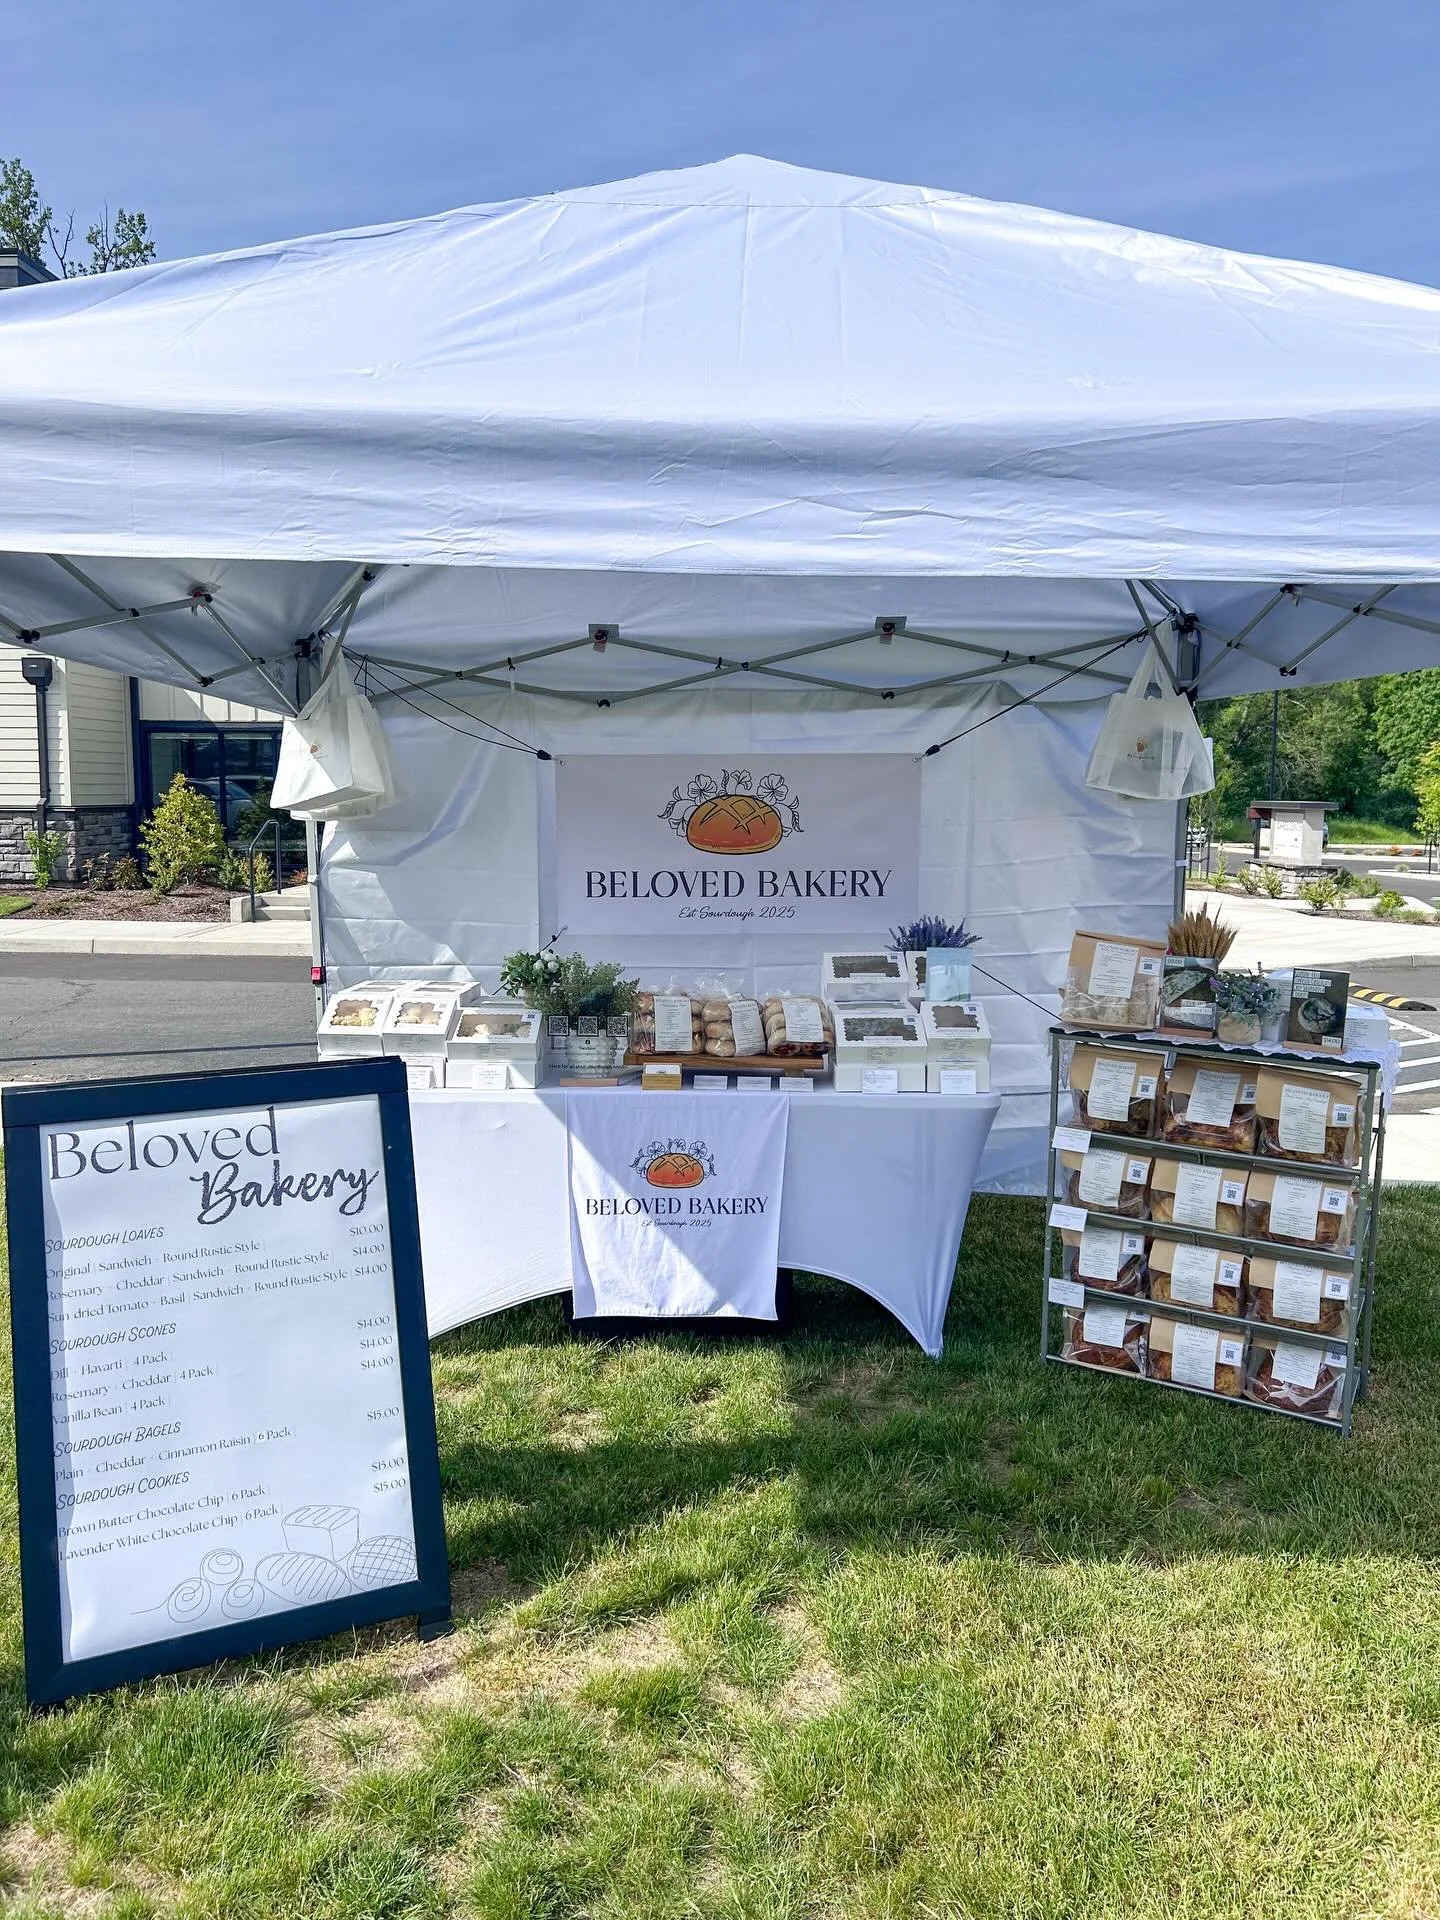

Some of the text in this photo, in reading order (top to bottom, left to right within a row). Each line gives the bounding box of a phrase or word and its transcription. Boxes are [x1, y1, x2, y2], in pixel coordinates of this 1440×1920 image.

[586, 870, 892, 898] BELOVED BAKERY
[679, 905, 795, 921] Est Sourdough 2025
[48, 1106, 280, 1180] Beloved
[190, 1160, 379, 1224] Bakery
[586, 1196, 769, 1215] BELOVED BAKERY
[690, 1218, 712, 1227] 2025
[46, 1223, 384, 1280] Original Sandwich Round Rustic Style $10.00
[47, 1243, 385, 1301] Rosemary Cheddar Sandwich Round Rustic Style $14.00
[107, 1300, 149, 1314] Tomato
[160, 1293, 185, 1306] Basil
[193, 1284, 244, 1301] Sandwich
[254, 1277, 288, 1292] Round
[290, 1273, 321, 1286] Rustic
[323, 1269, 348, 1281] Style
[354, 1263, 388, 1277] $14.00
[51, 1315, 390, 1381] Dill Havarti 4 Pack $14.00
[51, 1335, 393, 1403] Rosemary Cheddar 4 Pack $14.00
[51, 1356, 394, 1424] Vanilla Bean 4 Pack $14.00
[55, 1406, 400, 1481] Plain Cheddar Cinnamon Raisin 6 Pack $15.00
[58, 1457, 404, 1538] Brown Butter Chocolate Chip 6 Pack $15.00
[60, 1478, 406, 1561] Lavender White Chocolate Chip 6 Pack $15.00
